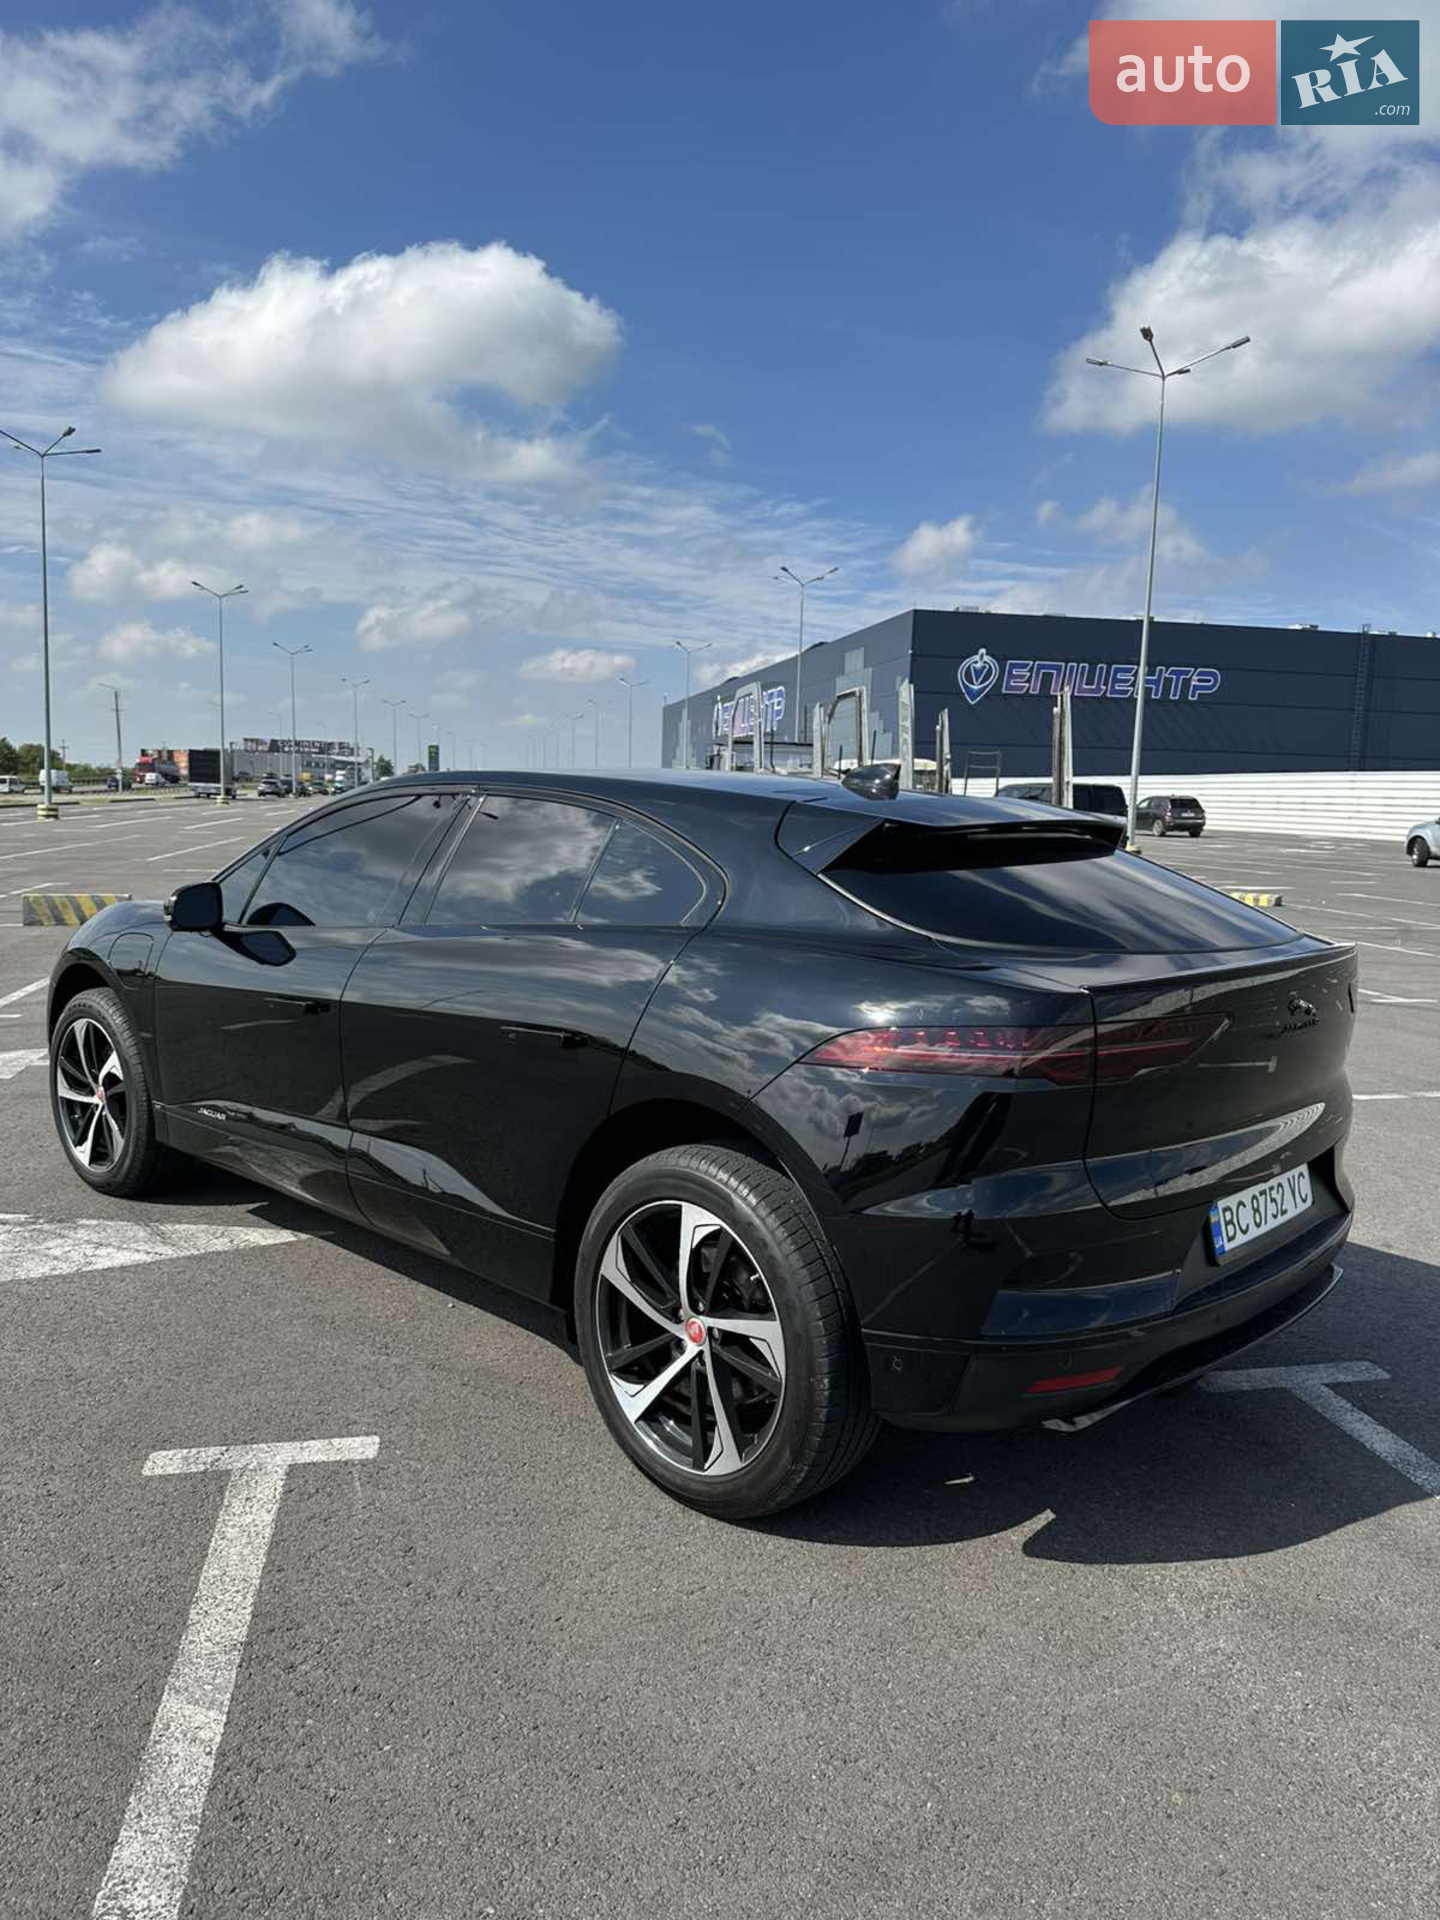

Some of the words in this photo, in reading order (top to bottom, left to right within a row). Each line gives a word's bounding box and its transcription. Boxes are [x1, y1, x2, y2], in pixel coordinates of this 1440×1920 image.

[1002, 659, 1221, 701] ЕПІЦЕНТР
[1221, 1199, 1250, 1243] BC
[1250, 1181, 1288, 1229] 8752
[1287, 1171, 1309, 1209] YC
